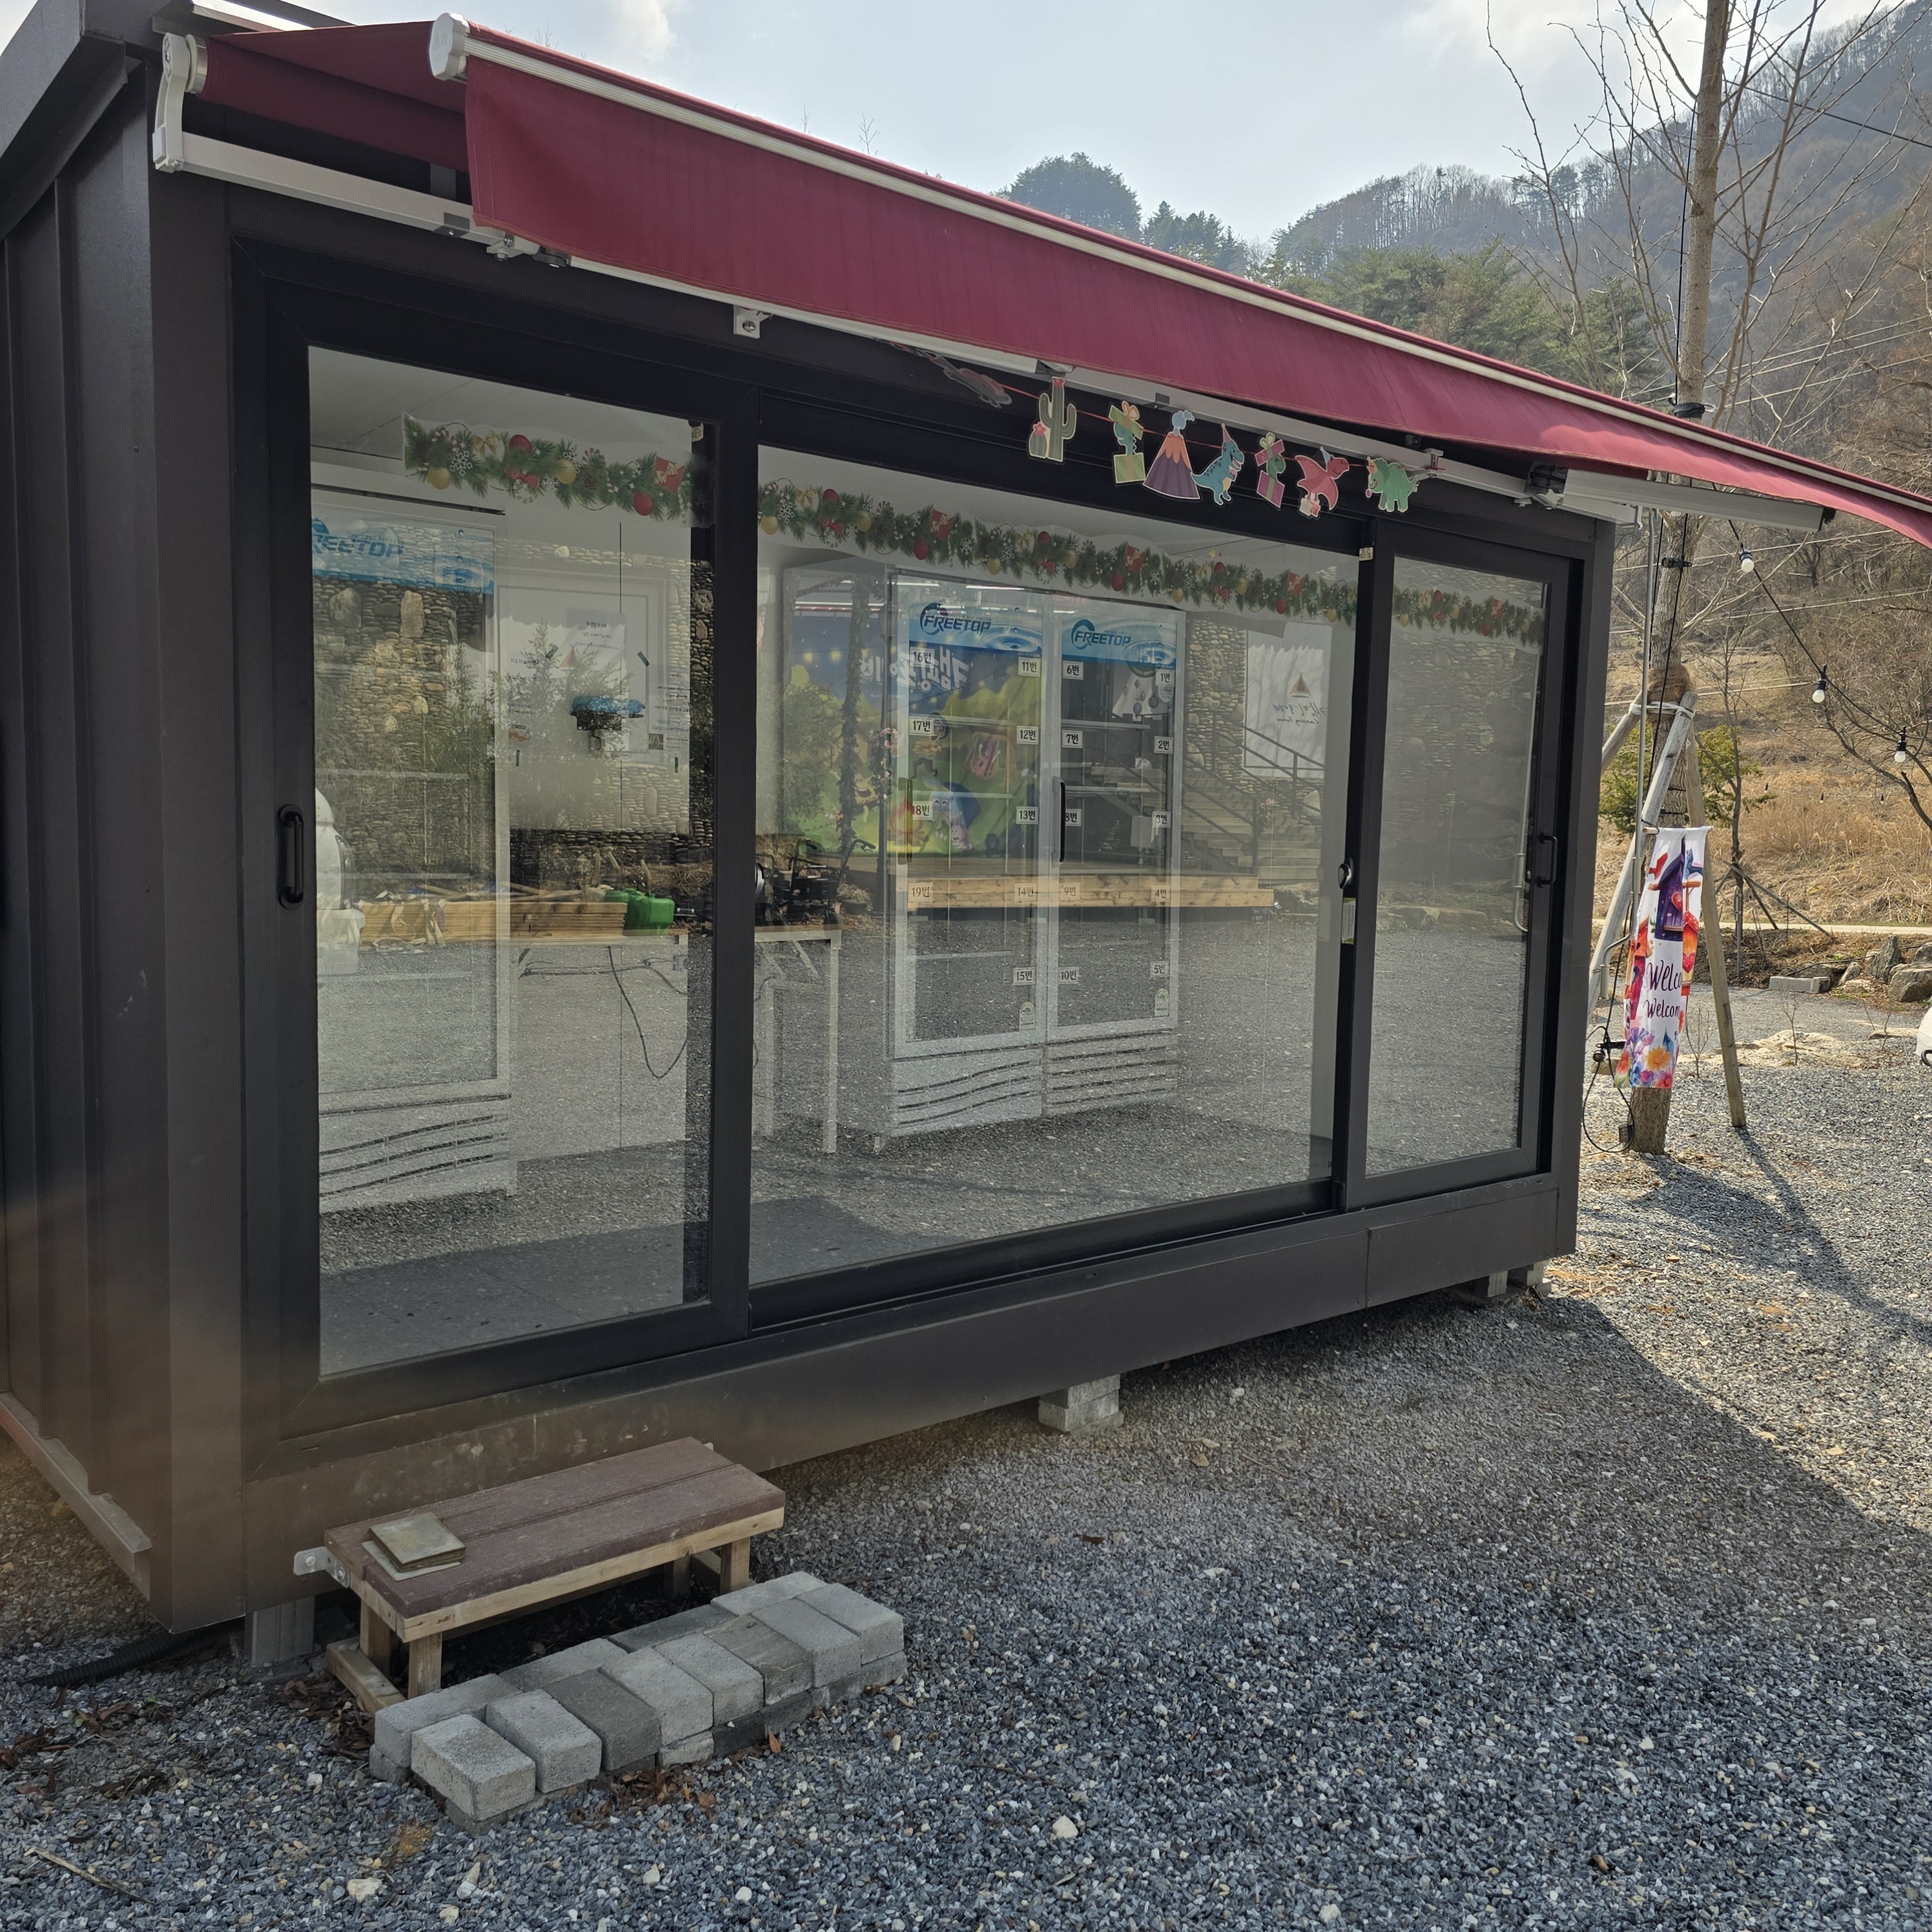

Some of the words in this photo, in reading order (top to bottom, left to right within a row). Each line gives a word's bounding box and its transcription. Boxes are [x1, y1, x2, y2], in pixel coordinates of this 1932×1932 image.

[923, 615, 991, 635] FREETOP
[1074, 630, 1131, 646] FREETOP
[912, 651, 932, 664] 16번
[1022, 661, 1037, 673] 11번
[1067, 664, 1080, 676] 6번
[1160, 672, 1171, 683] 1번
[912, 720, 931, 732] 17번
[1020, 729, 1036, 741] 12번
[1065, 734, 1079, 745] 7번
[1158, 739, 1170, 750] 2번
[912, 805, 930, 816] 18번
[1019, 810, 1036, 821] 13번
[1065, 812, 1078, 823] 8번
[1156, 814, 1167, 825] 3번
[911, 886, 930, 898] 19번
[1017, 887, 1034, 898] 14번
[1064, 886, 1076, 897] 9번
[1155, 888, 1167, 899] 4번
[1153, 964, 1166, 974] 5번
[1016, 971, 1033, 981] 15번
[1060, 970, 1078, 981] 10번
